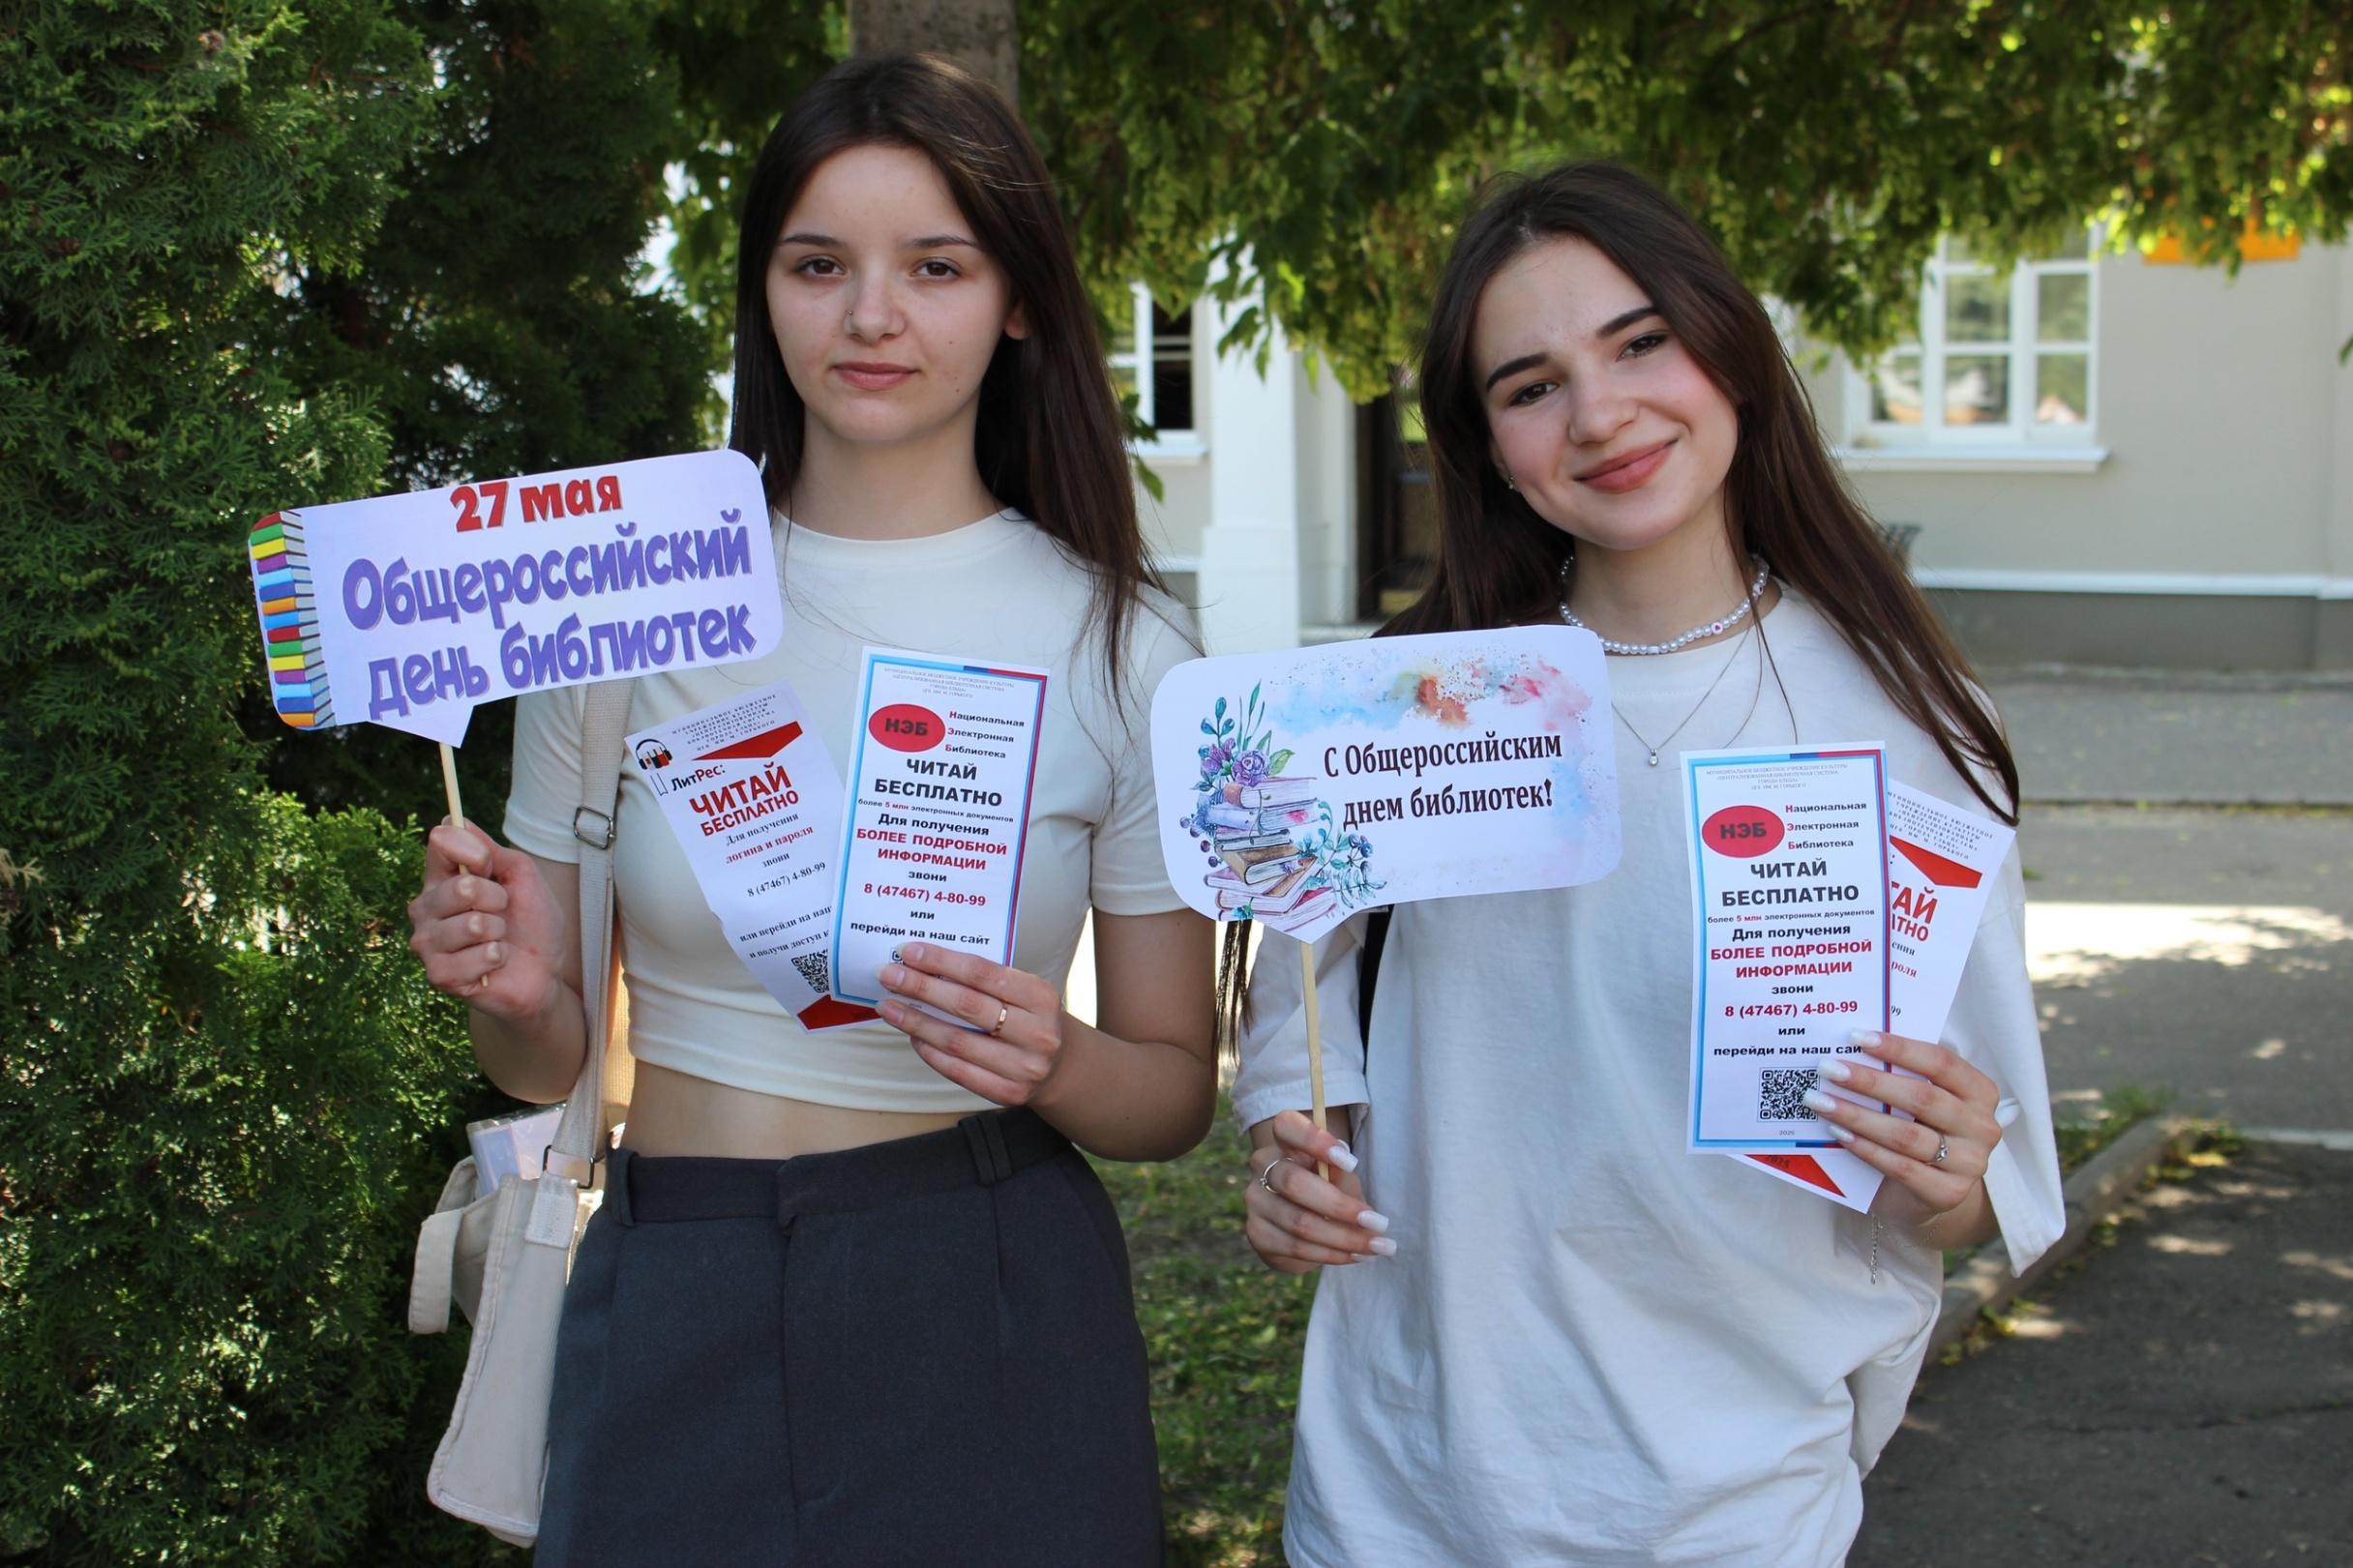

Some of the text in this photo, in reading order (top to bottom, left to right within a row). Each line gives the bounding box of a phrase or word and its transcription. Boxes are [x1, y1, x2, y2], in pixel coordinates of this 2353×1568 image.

[449, 475, 622, 533] 27 мая
[343, 508, 752, 630] Общероссийский
[369, 603, 758, 722] день библиотек
[884, 718, 928, 736] НЭБ
[949, 711, 1025, 727] Национальная
[947, 727, 1014, 743] Электронная
[945, 744, 1006, 758] Библиотека
[1324, 731, 1563, 777] С Общероссийским
[671, 764, 726, 791] ЛитРес:
[907, 758, 977, 781] ЧИТАЙ
[689, 761, 791, 816] ЧИТАЙ
[875, 779, 1002, 807] БЕСПЛАТНО
[700, 790, 799, 837] БЕСПЛАТНО
[858, 798, 882, 808] более
[911, 806, 965, 817] электронных
[967, 812, 1014, 823] документов
[1343, 778, 1553, 832] днем библиотек!
[1785, 803, 1867, 814] Национальная
[726, 813, 799, 846] Для получения
[879, 813, 989, 836] Для получения
[1719, 822, 1767, 839] НЭБ
[1787, 821, 1860, 832] Электронная
[726, 826, 814, 864] логина и пароля
[856, 828, 1007, 855] БОЛЕЕ ПОДРОБНОЙ
[1788, 840, 1854, 850] Библиотека
[762, 852, 790, 869] звони
[878, 848, 987, 870] ИНФОРМАЦИИ
[1750, 857, 1827, 879] ЧИТАЙ
[747, 861, 826, 897] 8 (47467) 4-80-99
[908, 871, 947, 882] звони
[864, 883, 986, 906] 8 (47467) 4-80-99
[1722, 885, 1860, 906] БЕСПЛАТНО
[910, 910, 935, 920] или
[1765, 912, 1822, 921] электронных
[1824, 909, 1875, 918] документов
[740, 932, 758, 942] или
[760, 919, 797, 936] перейди
[799, 913, 811, 923] на
[850, 922, 991, 945] перейди на наш сайт
[1732, 926, 1851, 942] Для получения
[758, 944, 789, 957] получи
[791, 932, 821, 949] доступ
[1711, 939, 1872, 961] БОЛЕЕ ПОДРОБНОЙ
[1736, 962, 1853, 978] ИНФОРМАЦИИ
[1772, 985, 1814, 994] звони
[1725, 1001, 1858, 1019] 8 (47467) 4-80-99
[1713, 1044, 1774, 1057] перейди
[1802, 1046, 1831, 1054] наш
